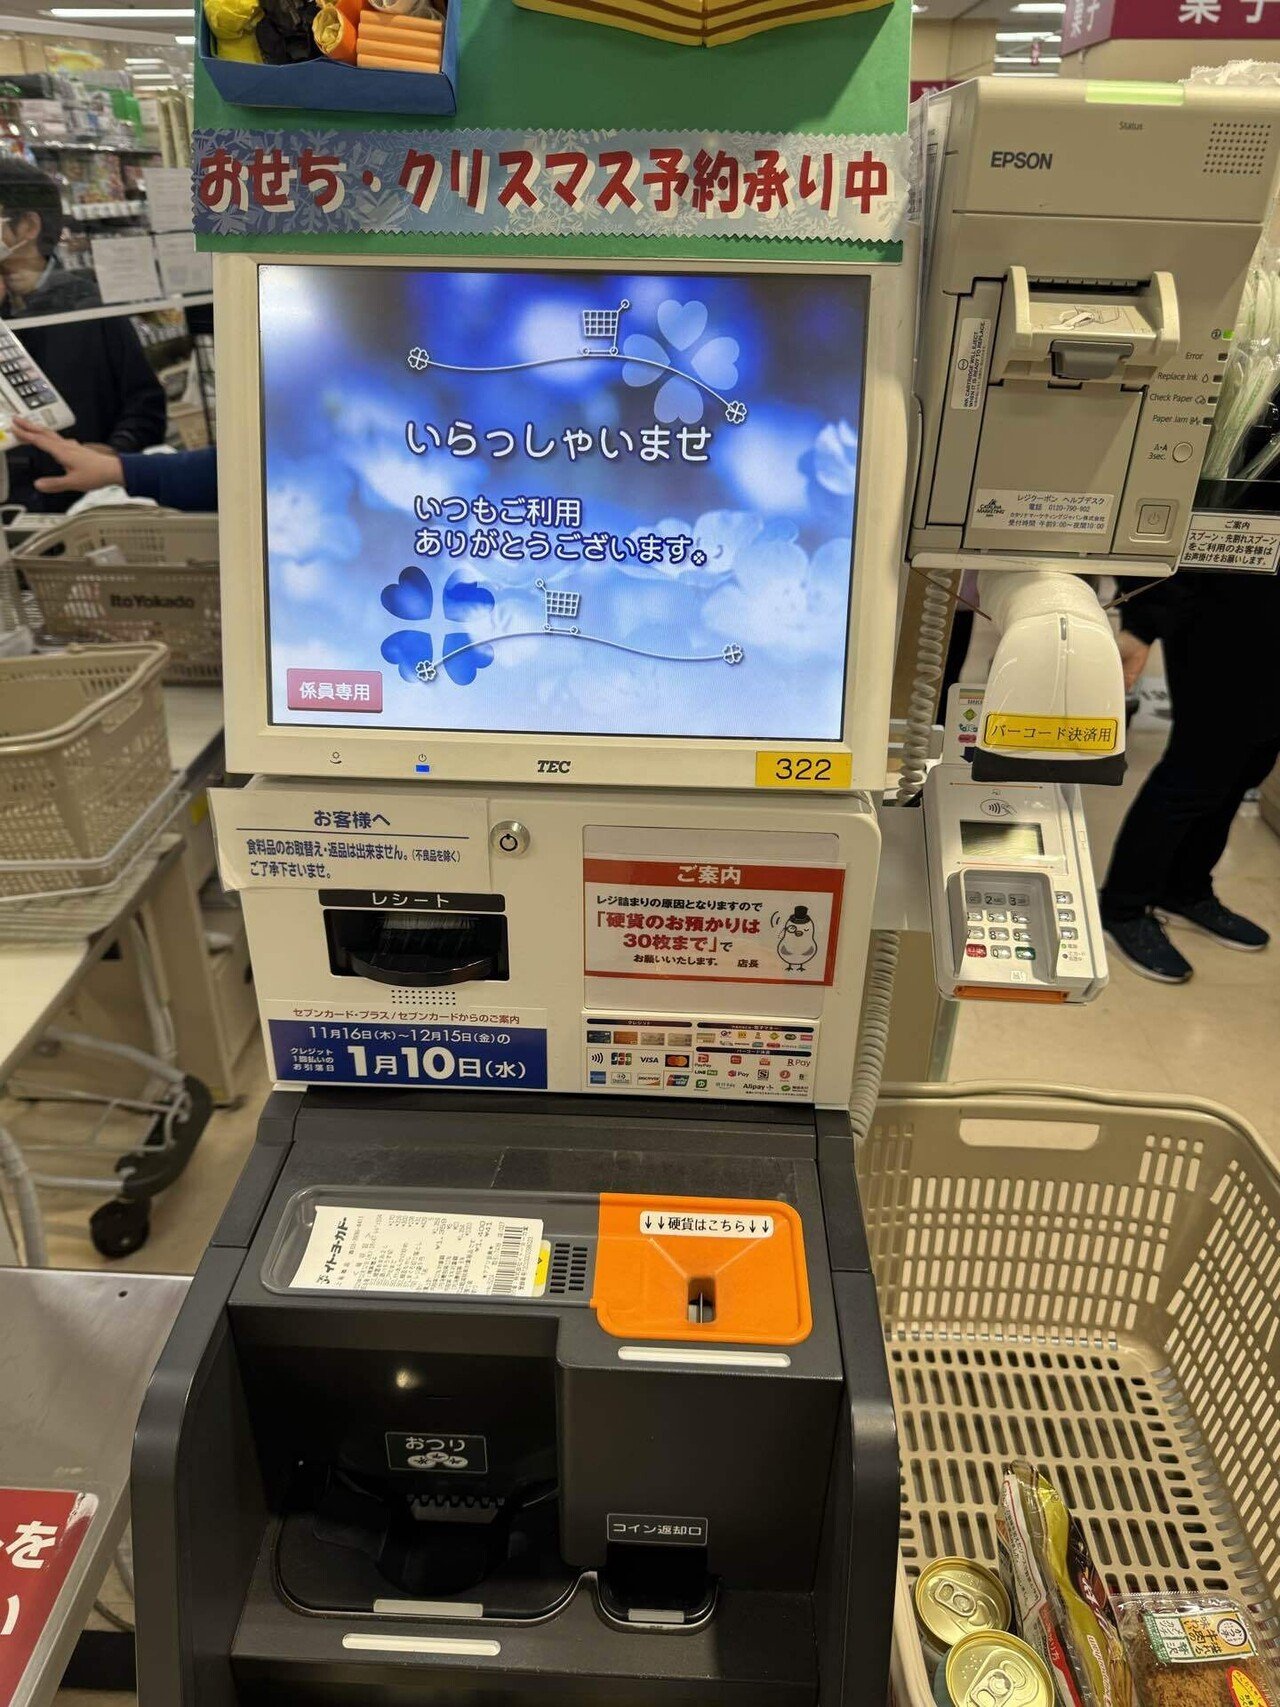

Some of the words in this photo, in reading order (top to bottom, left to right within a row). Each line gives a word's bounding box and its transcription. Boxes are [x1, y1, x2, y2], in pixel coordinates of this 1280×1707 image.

[1119, 120, 1143, 131] Status
[990, 152, 1052, 170] EPSON
[199, 148, 889, 215] おせち・クリスマス予約承り中
[1185, 352, 1203, 360] Error
[965, 365, 974, 396] CARTRIDGE
[1157, 372, 1185, 381] Replace
[1187, 372, 1198, 380] Ink
[1150, 393, 1171, 401] Check
[1173, 395, 1193, 403] Paper
[1153, 414, 1173, 423] Paper
[405, 420, 712, 462] いらっしゃいませ
[1017, 494, 1058, 503] レジクーポン
[1063, 496, 1105, 505] ヘルプデスク
[414, 496, 582, 527] いつもご利用
[1225, 520, 1250, 530] ご案内
[1189, 531, 1277, 545] スプーン・先割れスプーン
[1188, 543, 1273, 555] をご利用のお客様は
[1184, 552, 1266, 565] お声掛けをお願いします。
[299, 681, 370, 701] 係員専用
[990, 724, 1112, 743] バーコード決済用
[537, 760, 572, 774] TEC
[775, 758, 832, 781] 322
[313, 810, 391, 829] お客様へ
[250, 861, 331, 879] ご了承下さいませ。
[677, 864, 742, 885] ご案内
[372, 892, 449, 909] レシート
[596, 895, 763, 912] レジ詰まりの原因となりますので
[597, 910, 760, 934] 「硬貨のお預かりは
[623, 933, 733, 953] 30枚まで」で
[633, 953, 718, 967] お願いいたします。
[737, 959, 759, 969] 店長
[290, 1047, 334, 1055] クレジット
[293, 1055, 334, 1064] 1回払いの
[347, 1045, 526, 1080] 1月10日(水)
[795, 1059, 811, 1068] Pay
[668, 1216, 746, 1232] 硬貨はこちら
[405, 1436, 466, 1451] おつり
[612, 1522, 702, 1536] コイン返却口
[6, 1521, 59, 1569] を
[1186, 1628, 1219, 1645] 牛肉の
